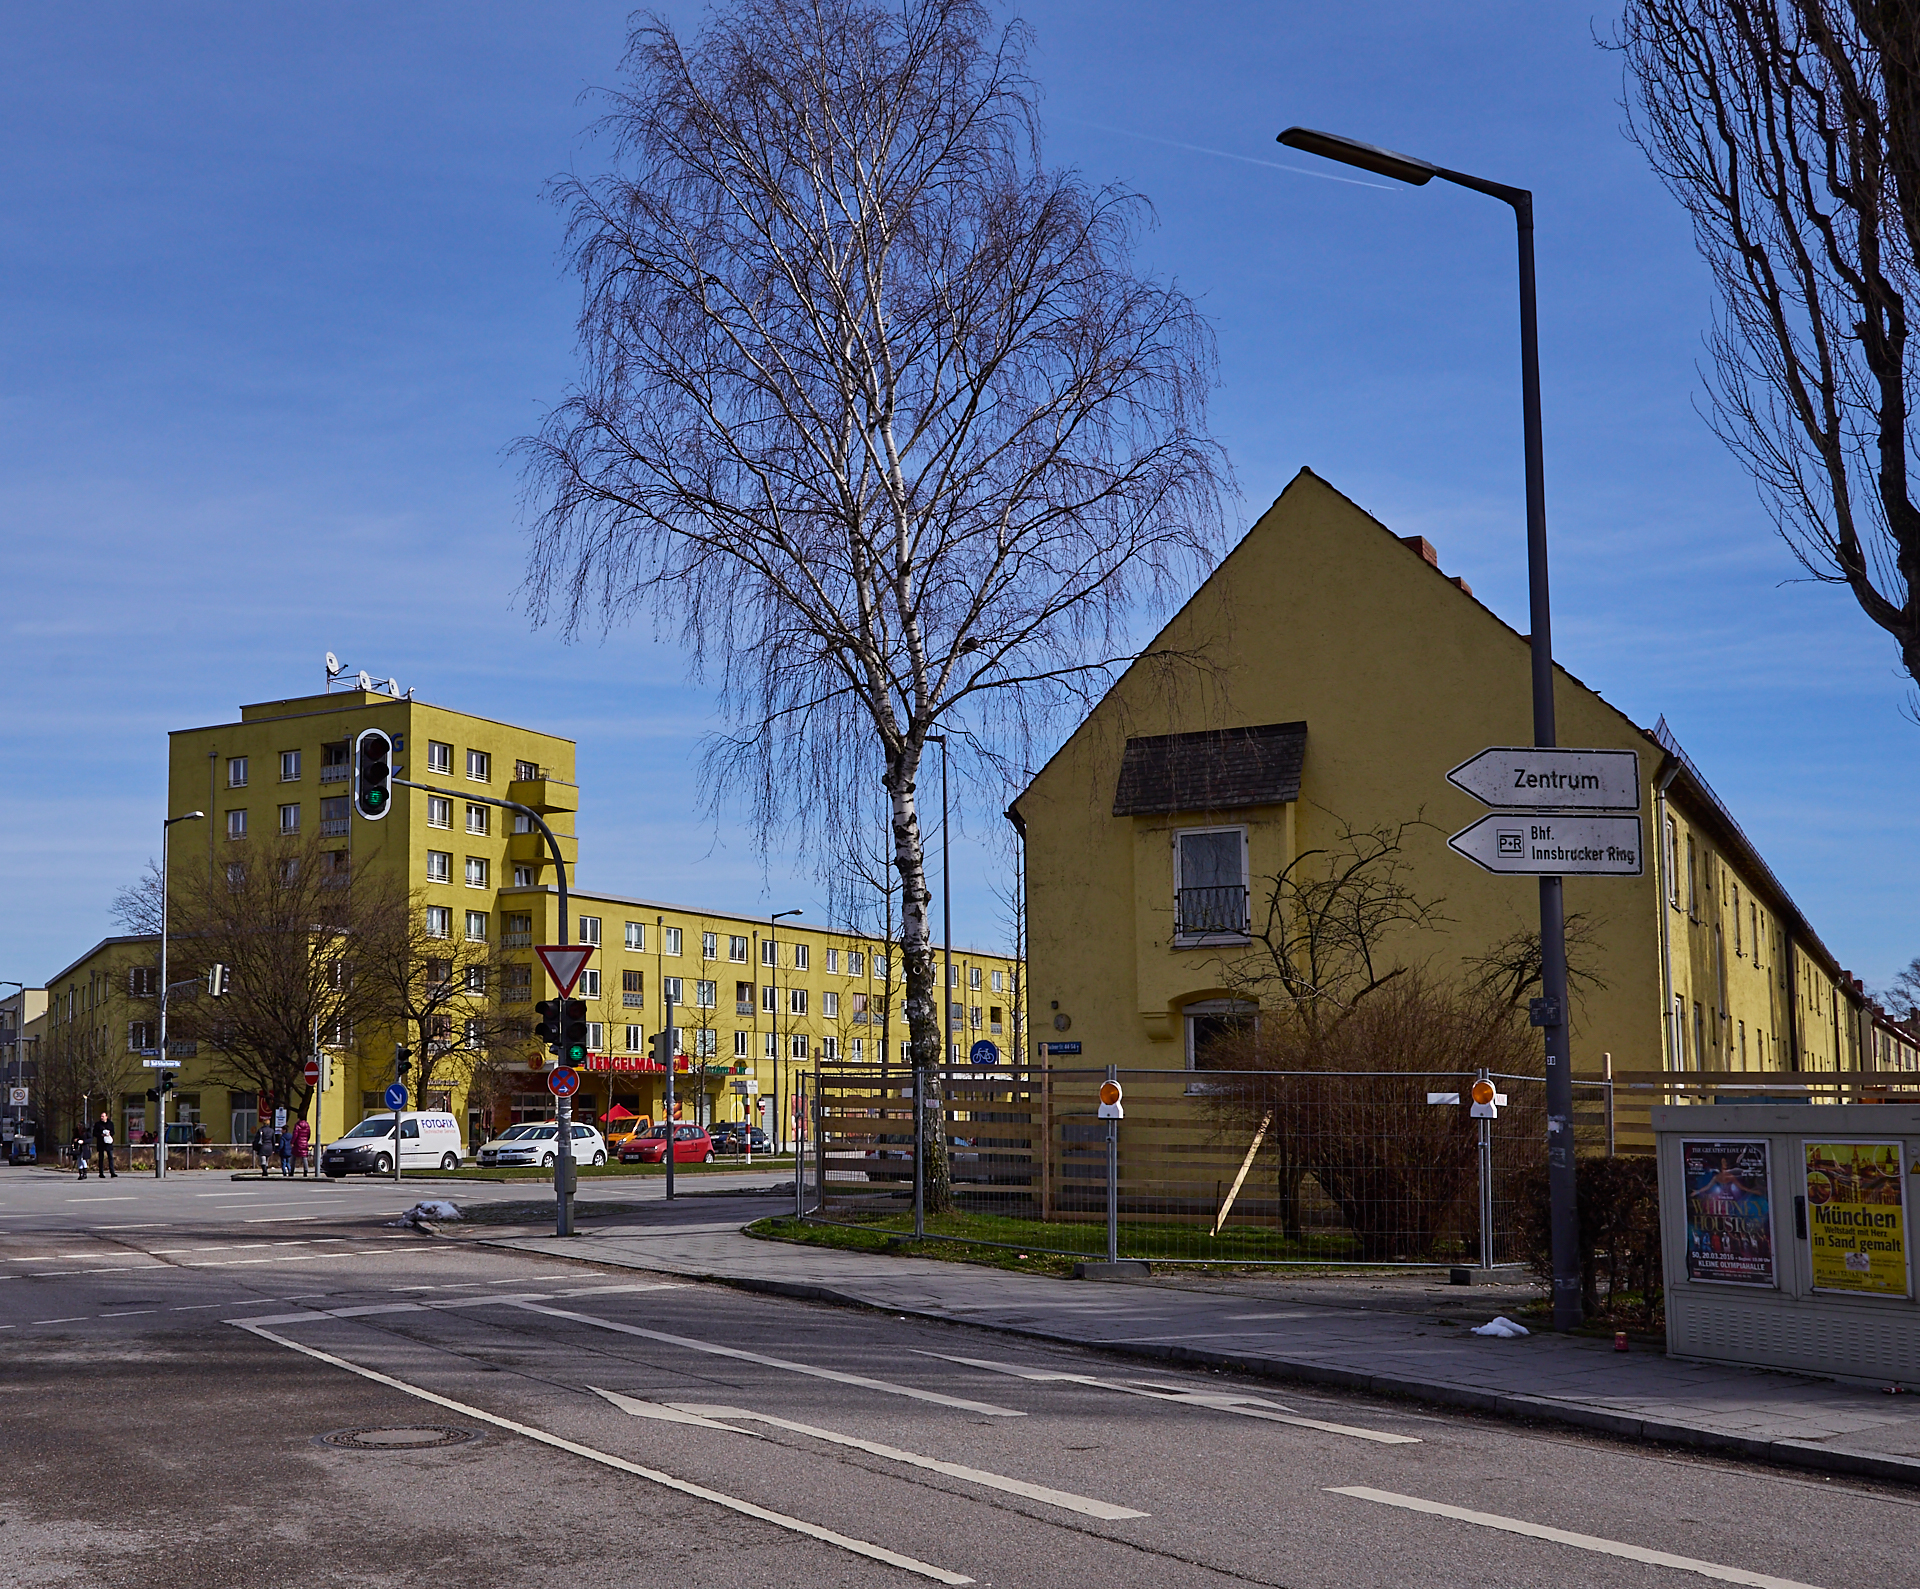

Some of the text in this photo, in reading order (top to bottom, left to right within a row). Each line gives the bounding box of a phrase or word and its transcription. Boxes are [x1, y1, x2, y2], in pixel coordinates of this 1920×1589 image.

[1514, 768, 1599, 790] Zentrum
[1531, 826, 1555, 840] Bhf.
[1499, 838, 1522, 850] P+R
[1531, 845, 1635, 864] Innsbrucker Ring
[1691, 1199, 1763, 1217] WHITNEY
[1815, 1205, 1897, 1229] München
[1824, 1226, 1887, 1237] Weltstadt mit Herz
[1814, 1233, 1901, 1253] in Sand gemalt
[1702, 1252, 1735, 1261] 20.03.2016
[1698, 1260, 1765, 1270] KLEINE OLYMPIAHALLE
